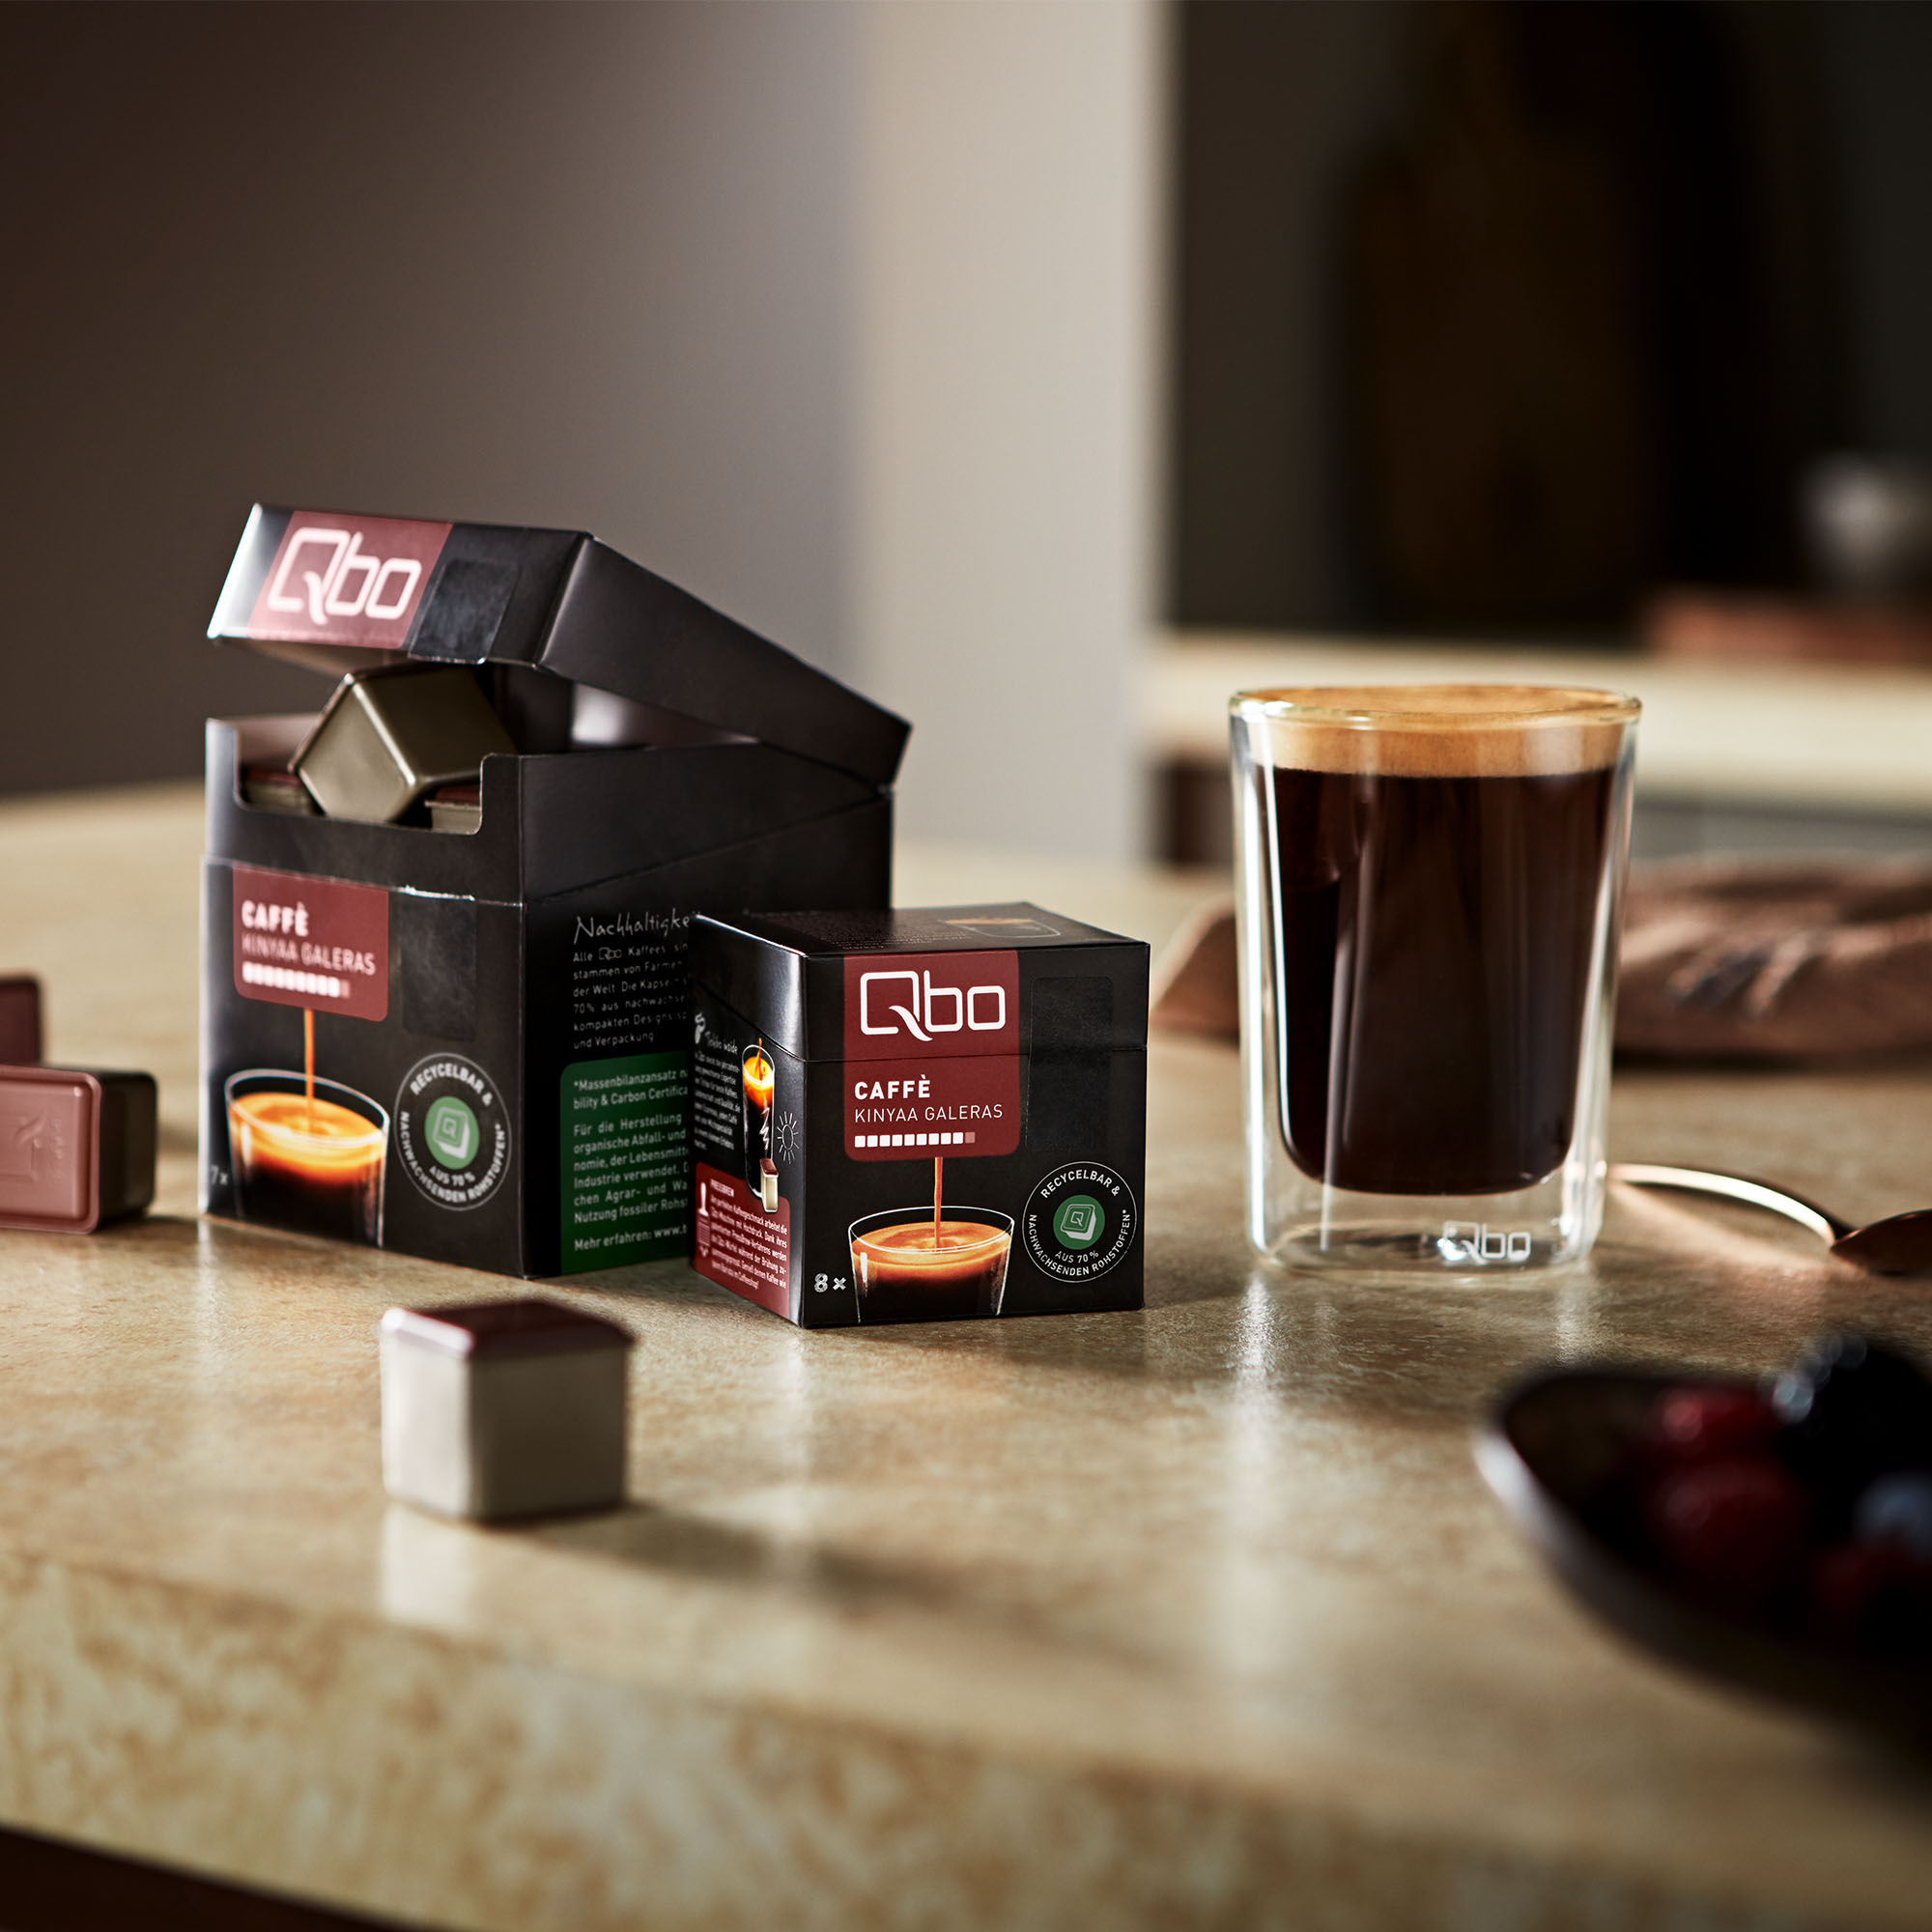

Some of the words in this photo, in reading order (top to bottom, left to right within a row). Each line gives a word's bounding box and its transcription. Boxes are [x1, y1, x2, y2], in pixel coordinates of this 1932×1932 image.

[267, 526, 422, 625] Qbo
[242, 900, 309, 937] CAFFÈ
[573, 907, 700, 946] Nachhaltigke
[242, 933, 298, 963] KINYAA
[301, 941, 376, 977] GALERAS
[573, 952, 593, 963] Alle
[573, 967, 620, 980] stammen
[623, 966, 641, 976] von
[573, 986, 589, 998] der
[601, 1002, 619, 1012] aus
[860, 969, 1006, 1042] Qbo
[573, 1018, 630, 1032] kompakten
[573, 1037, 592, 1050] und
[411, 1063, 484, 1095] RECYCELBAR
[481, 1089, 493, 1106] &
[854, 1074, 931, 1100] CAFFÈ
[573, 1095, 598, 1111] bility
[600, 1094, 609, 1107] &
[610, 1091, 646, 1105] Carbon
[854, 1107, 918, 1123] KINYAA
[924, 1103, 1003, 1122] GALERAS
[573, 1122, 592, 1137] Für
[598, 1120, 614, 1133] die
[619, 1113, 682, 1130] Herstellung
[573, 1137, 630, 1156] organische
[631, 1130, 666, 1147] Abfall-
[667, 1126, 687, 1141] und
[401, 1111, 467, 1203] NACHWACHSENDEN
[573, 1156, 609, 1173] nomie,
[610, 1153, 628, 1167] der
[573, 1171, 621, 1190] Industrie
[622, 1164, 680, 1181] verwendet.
[1040, 1169, 1113, 1199] RECYCELBAR
[1111, 1185, 1121, 1197] &
[573, 1193, 600, 1208] chen
[605, 1188, 640, 1206] Agrar-
[646, 1181, 667, 1197] und
[574, 1208, 617, 1225] Nutzung
[618, 1201, 659, 1217] fossiler
[574, 1236, 602, 1252] Mehr
[602, 1231, 652, 1247] erfahren:
[764, 1231, 775, 1244] Dank
[776, 1236, 787, 1249] ihres
[1028, 1214, 1090, 1276] NACHWACHSENDEN
[1441, 1220, 1532, 1266] Qbo
[772, 1249, 787, 1263] werden
[1055, 1250, 1074, 1264] AUS
[813, 1273, 829, 1293] 8
